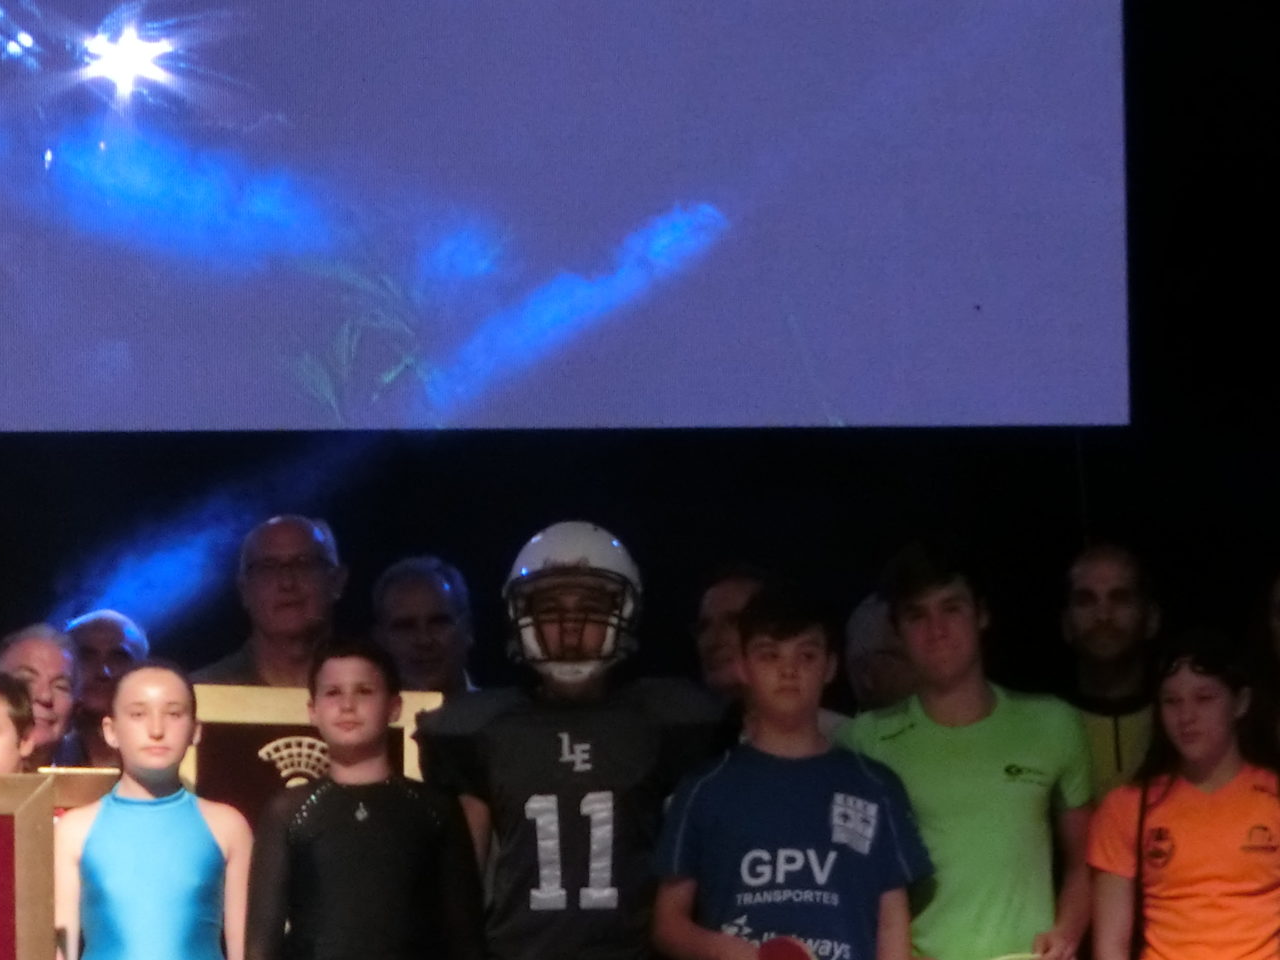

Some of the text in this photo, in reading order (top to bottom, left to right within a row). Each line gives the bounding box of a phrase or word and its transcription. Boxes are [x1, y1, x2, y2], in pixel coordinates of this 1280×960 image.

[524, 790, 619, 910] 11
[740, 848, 838, 886] GPV
[736, 889, 839, 906] TRANSPORTES
